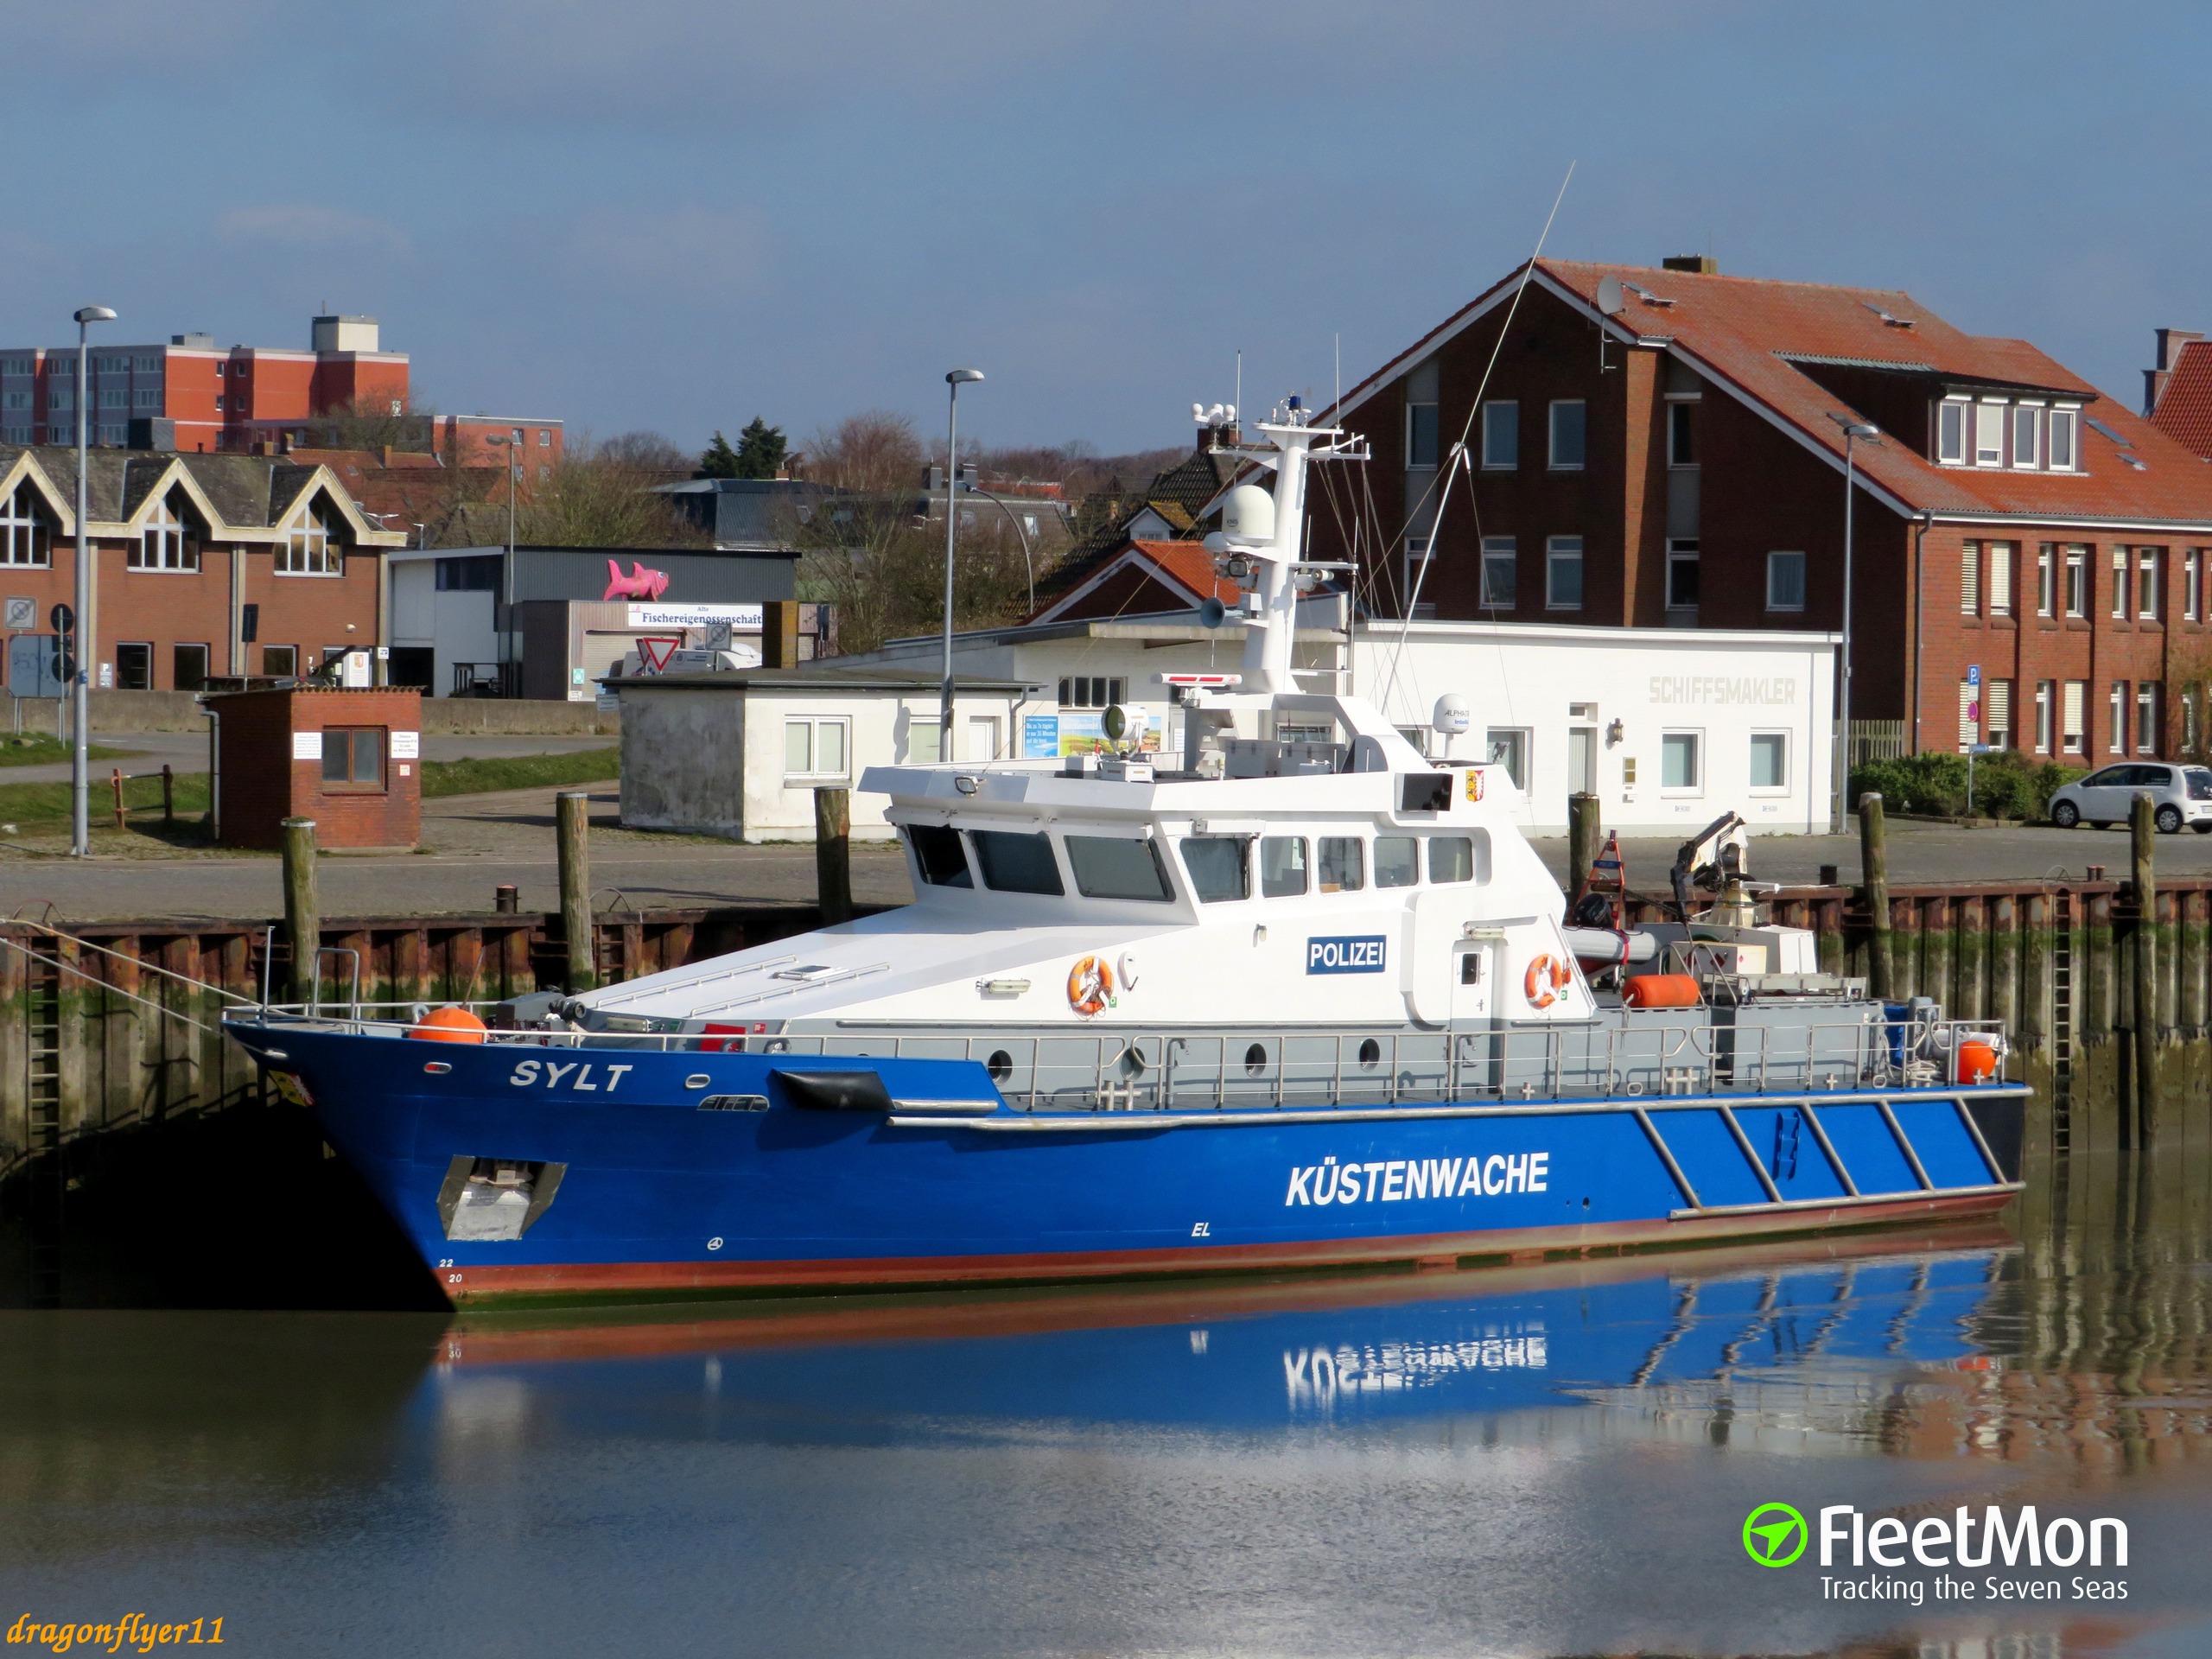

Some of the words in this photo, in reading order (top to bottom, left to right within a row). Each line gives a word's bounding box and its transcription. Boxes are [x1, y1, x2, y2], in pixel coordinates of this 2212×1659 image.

[642, 613, 762, 624] Fischereigenossenschaft
[1649, 677, 1796, 704] SCHIFFSMAKLER
[1310, 942, 1383, 967] POLIZEI
[510, 1060, 633, 1091] SYLT
[1285, 1152, 1548, 1206] KÜSTENWACHE
[1191, 1222, 1211, 1237] EL
[439, 1259, 454, 1268] 22
[449, 1274, 462, 1283] 20
